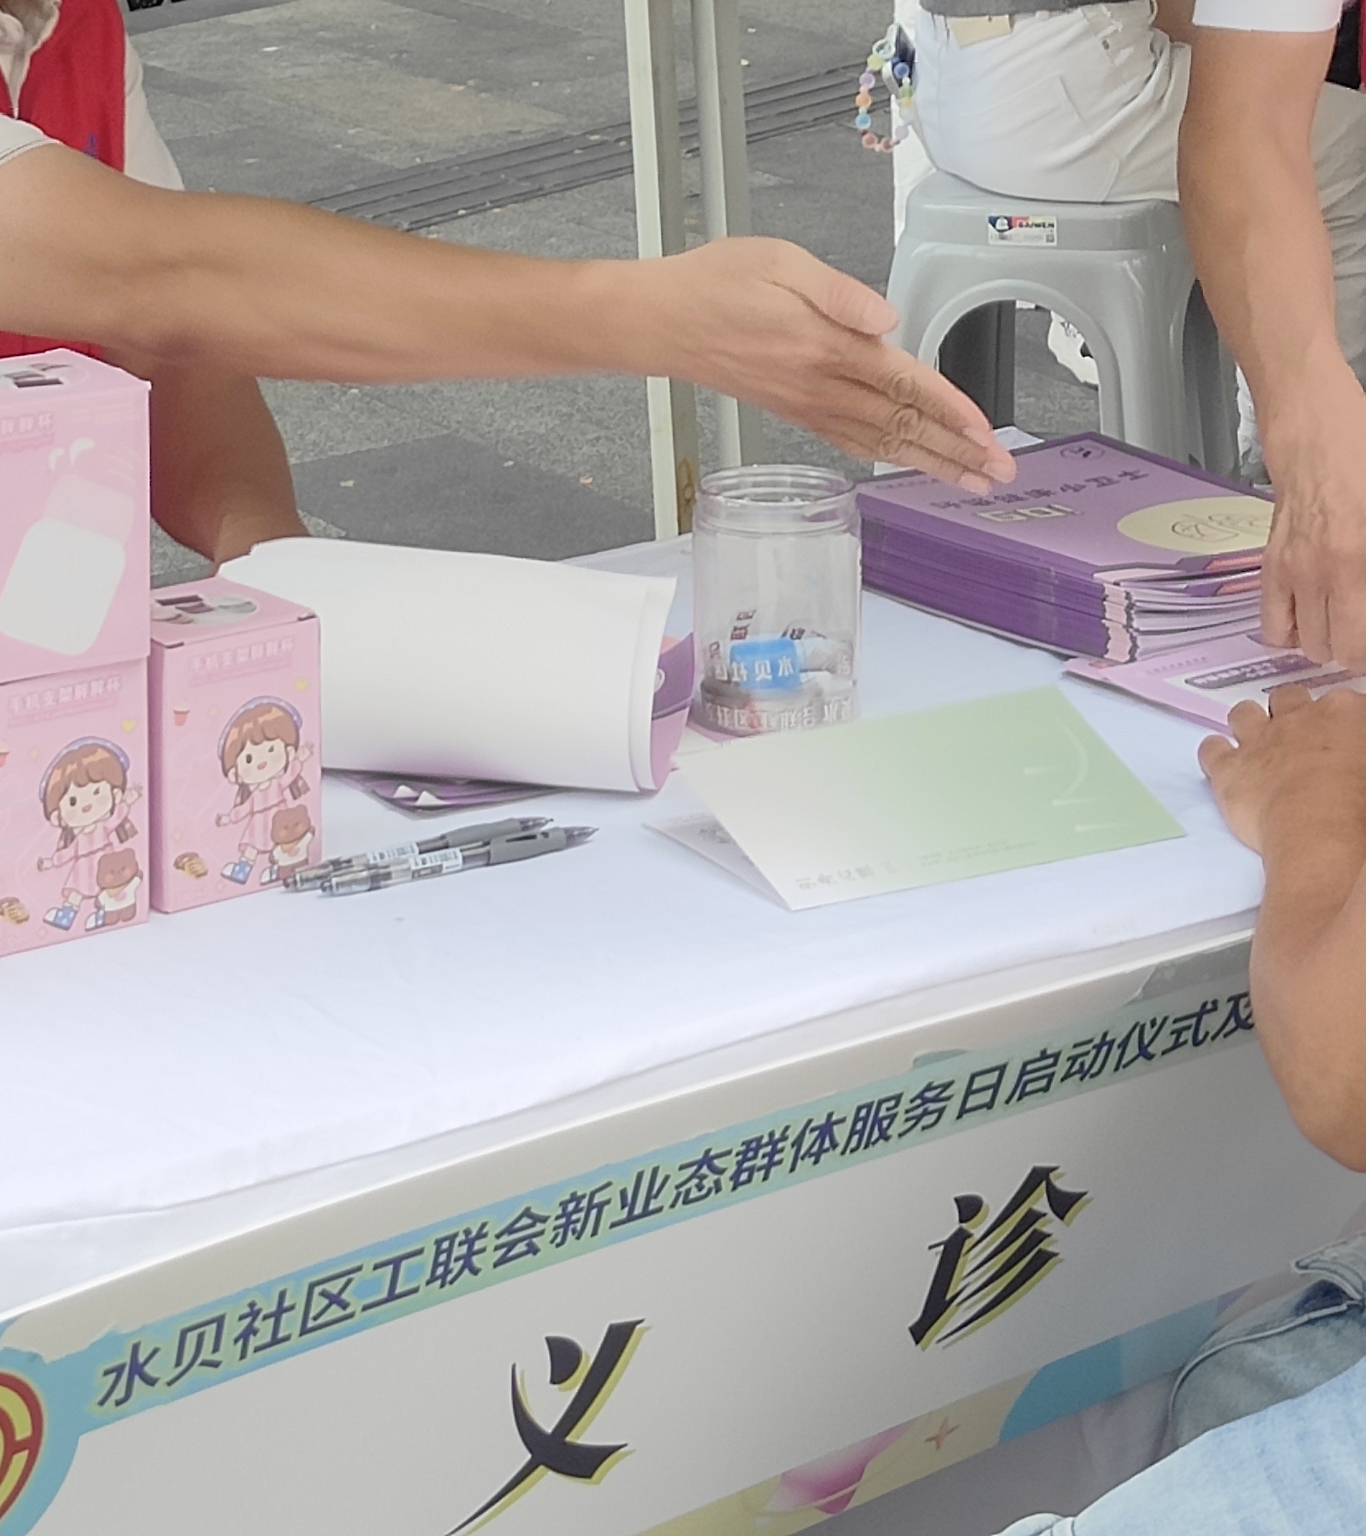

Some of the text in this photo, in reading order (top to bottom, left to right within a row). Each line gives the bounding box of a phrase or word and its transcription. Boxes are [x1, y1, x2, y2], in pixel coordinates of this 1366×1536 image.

[97, 992, 1255, 1410] 水贝社区工联会新业态群体服务日启动仪式及
